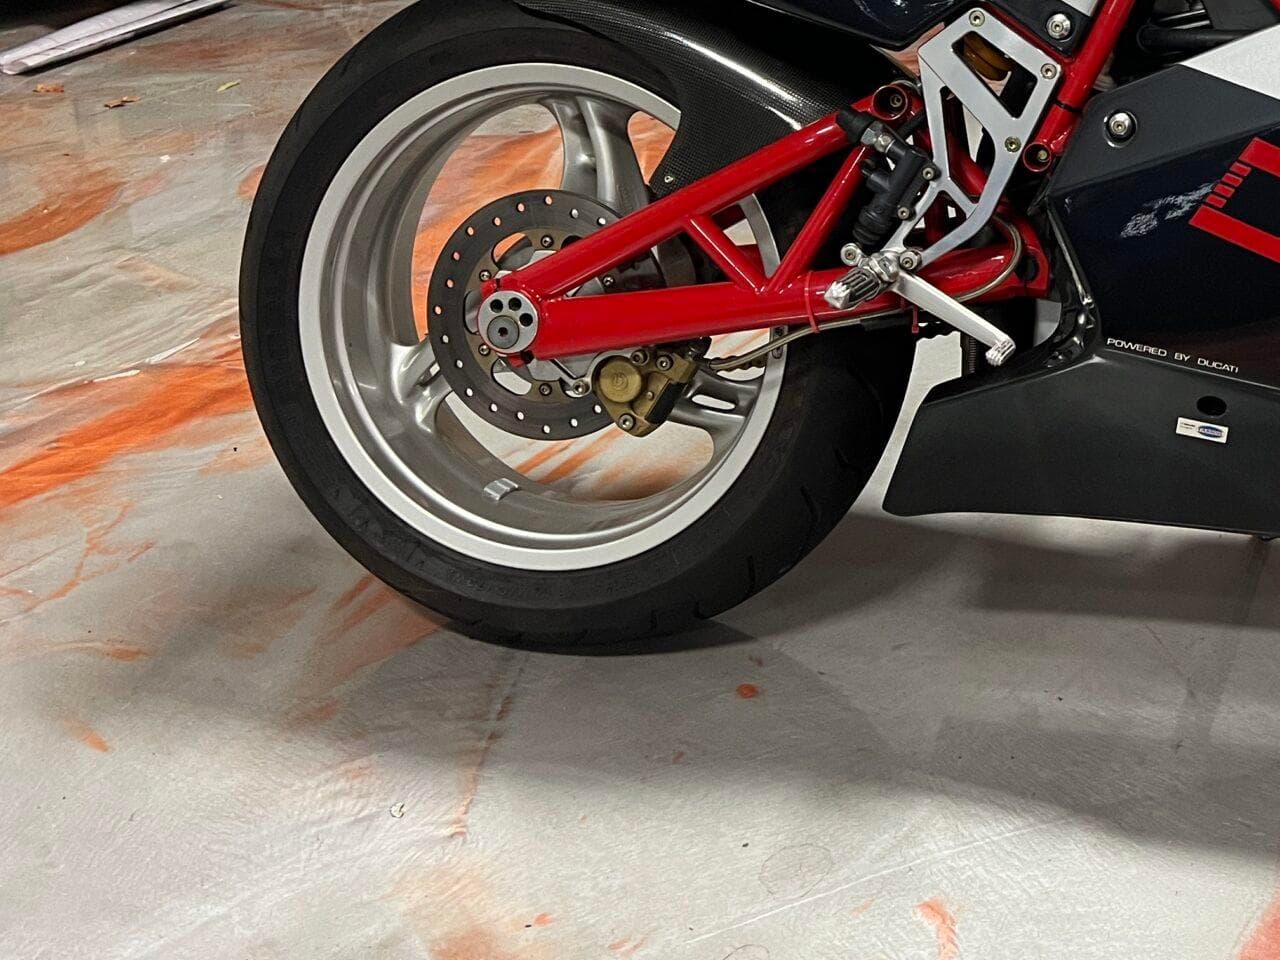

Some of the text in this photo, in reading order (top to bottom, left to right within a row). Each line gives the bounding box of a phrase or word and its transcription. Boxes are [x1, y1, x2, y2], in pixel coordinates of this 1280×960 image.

[1106, 337, 1239, 374] POWERED BY DUCATI
